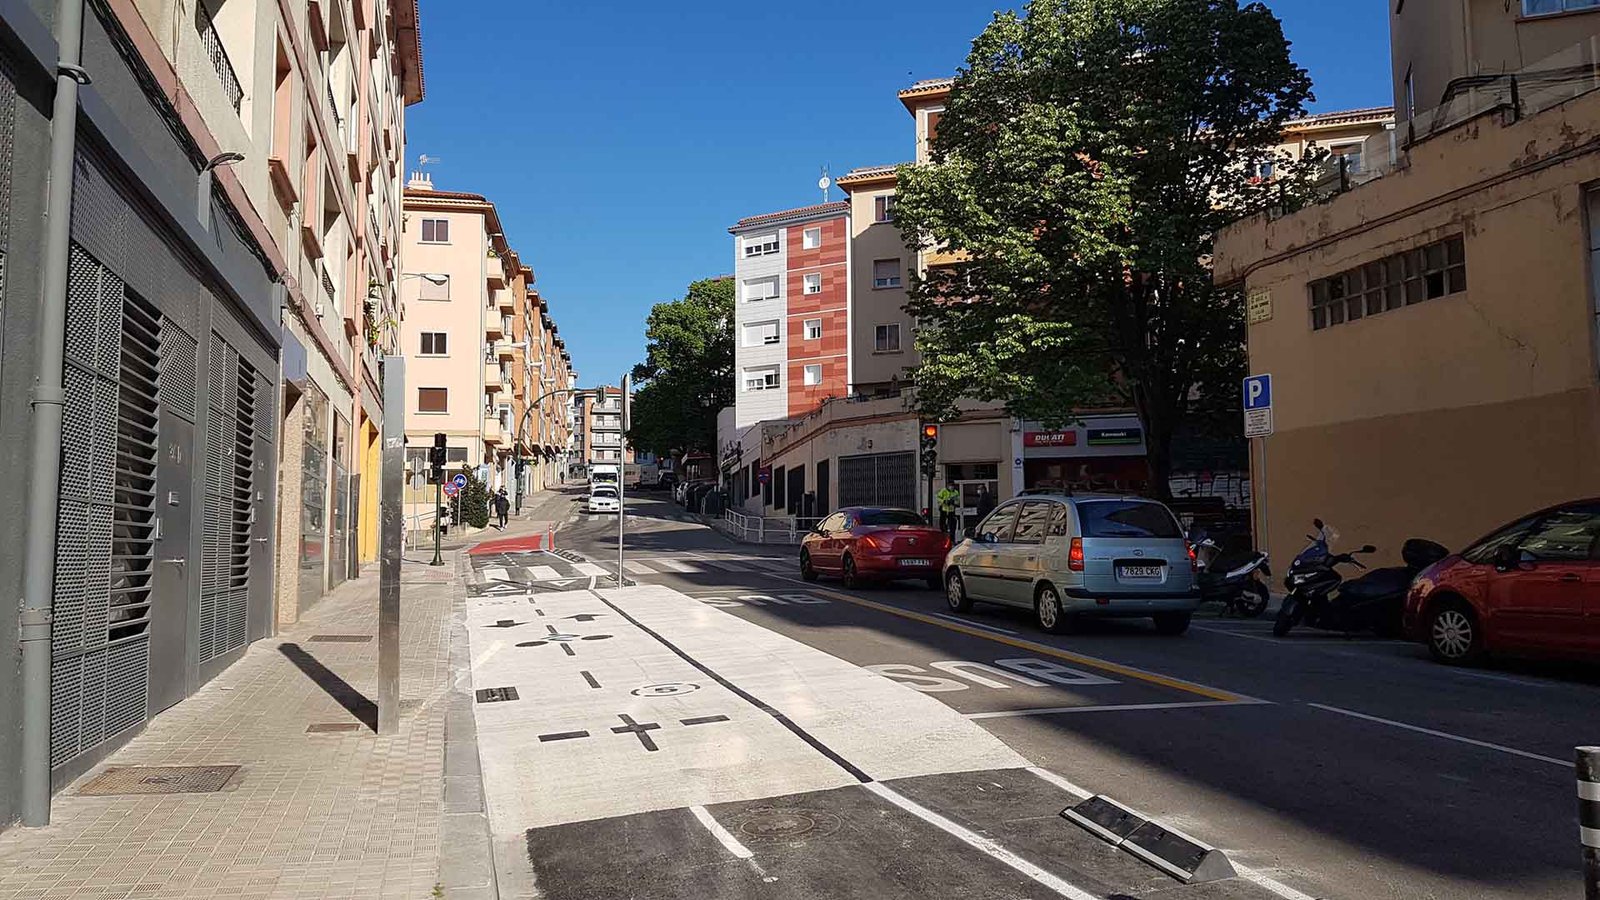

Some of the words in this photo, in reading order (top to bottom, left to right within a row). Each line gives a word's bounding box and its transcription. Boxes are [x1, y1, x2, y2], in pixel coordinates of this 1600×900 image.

[1249, 379, 1262, 407] P
[697, 594, 833, 608] BUS
[863, 657, 1122, 693] BUS
